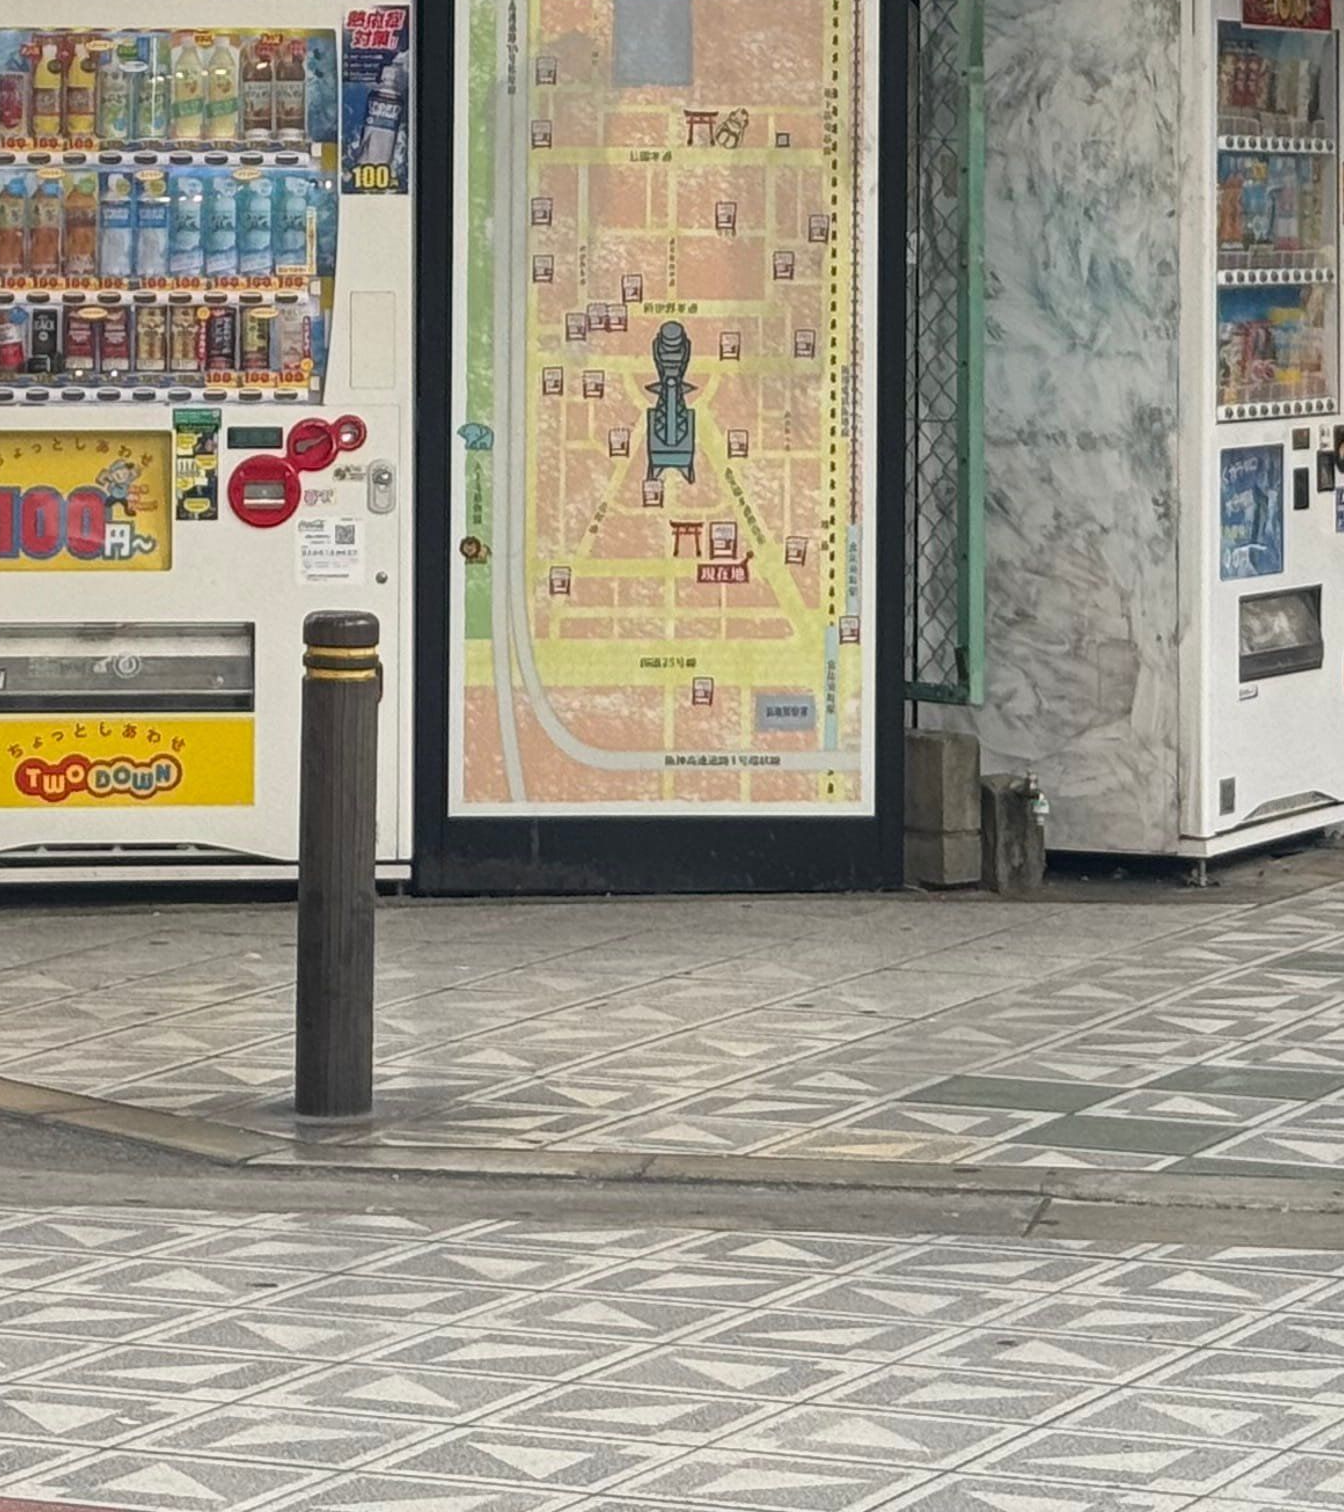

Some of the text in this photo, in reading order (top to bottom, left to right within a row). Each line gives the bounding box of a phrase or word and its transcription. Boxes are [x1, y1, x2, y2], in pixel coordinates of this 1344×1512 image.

[8, 722, 186, 759] ちょっとしあわせ
[25, 763, 172, 794] TWO DOWN
